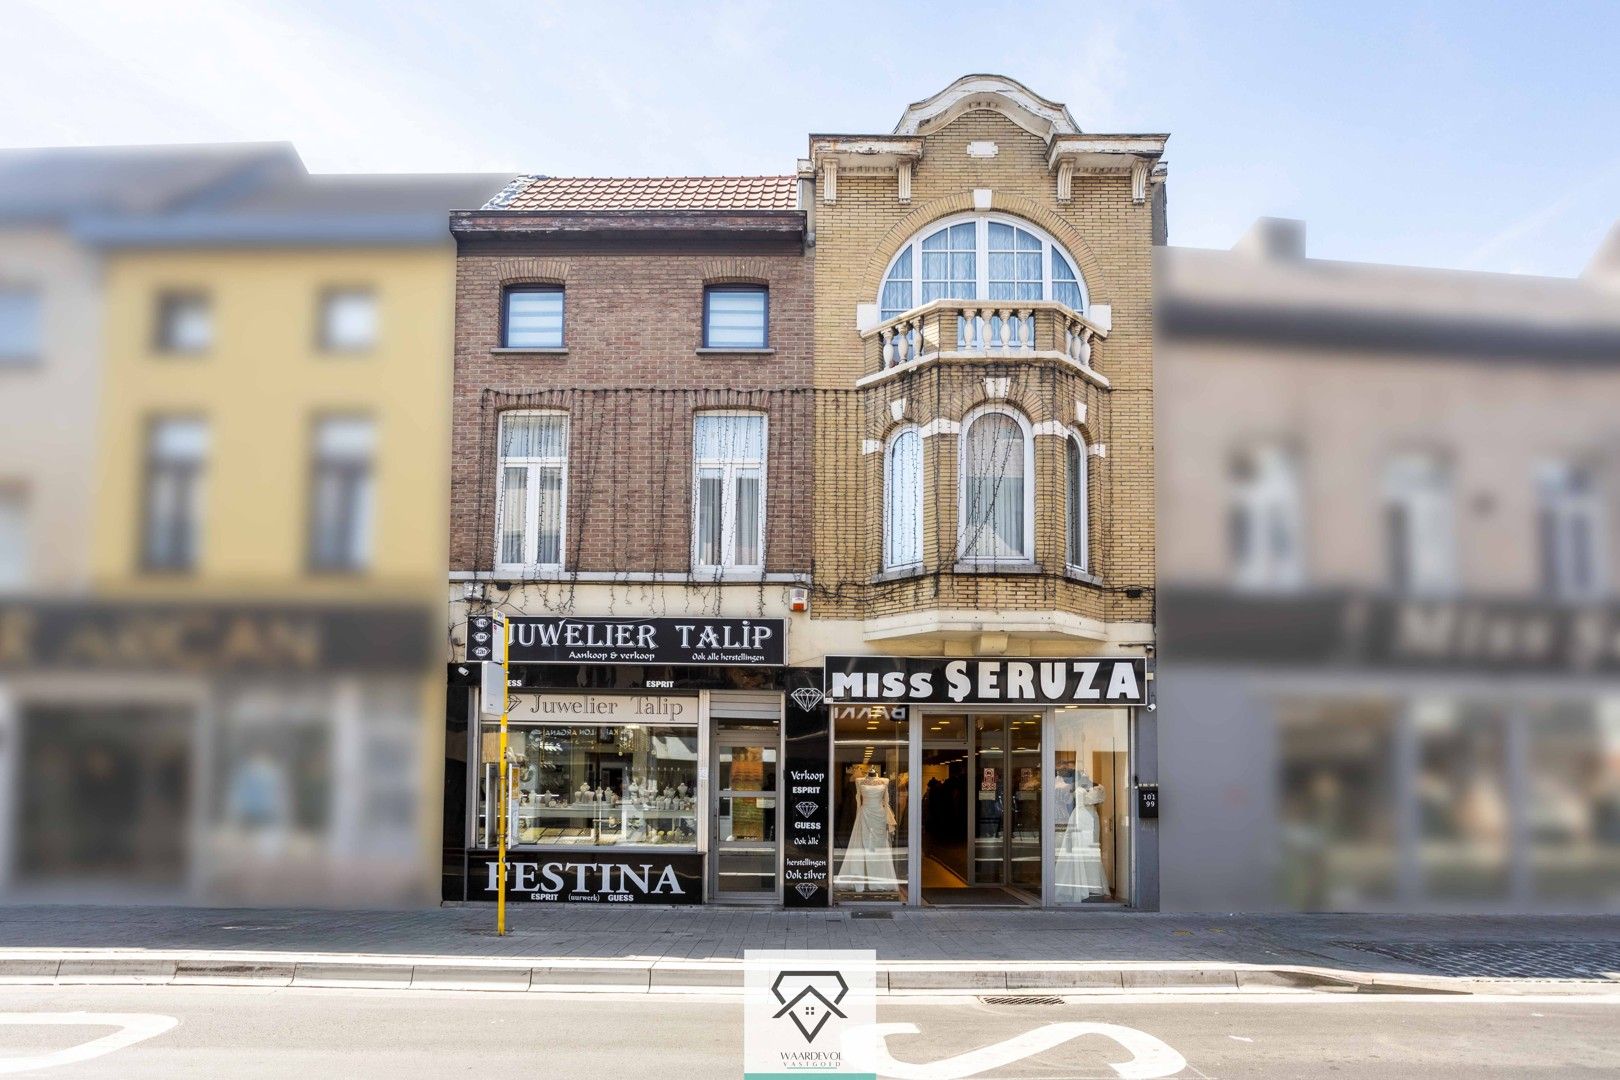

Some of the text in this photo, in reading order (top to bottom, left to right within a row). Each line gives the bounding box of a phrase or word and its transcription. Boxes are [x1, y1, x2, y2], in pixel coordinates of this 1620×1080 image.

[568, 650, 655, 661] Aankoop & verkoop
[692, 652, 765, 663] Ook alle herstellingen
[508, 679, 522, 687] ESS
[646, 680, 674, 688] ESPRIT
[945, 660, 1140, 702] ŞERUZA
[529, 694, 683, 721] Juwelier Talip
[790, 770, 825, 782] Verkoop
[792, 786, 821, 794] ESPRIT
[794, 821, 821, 830] GUESS
[793, 836, 819, 845] Ook alle
[786, 858, 827, 868] herstellingen
[484, 861, 686, 894] FESTINA
[785, 869, 827, 880] Ook zilver
[531, 893, 559, 901] ESPRIT
[607, 894, 634, 902] GUESS
